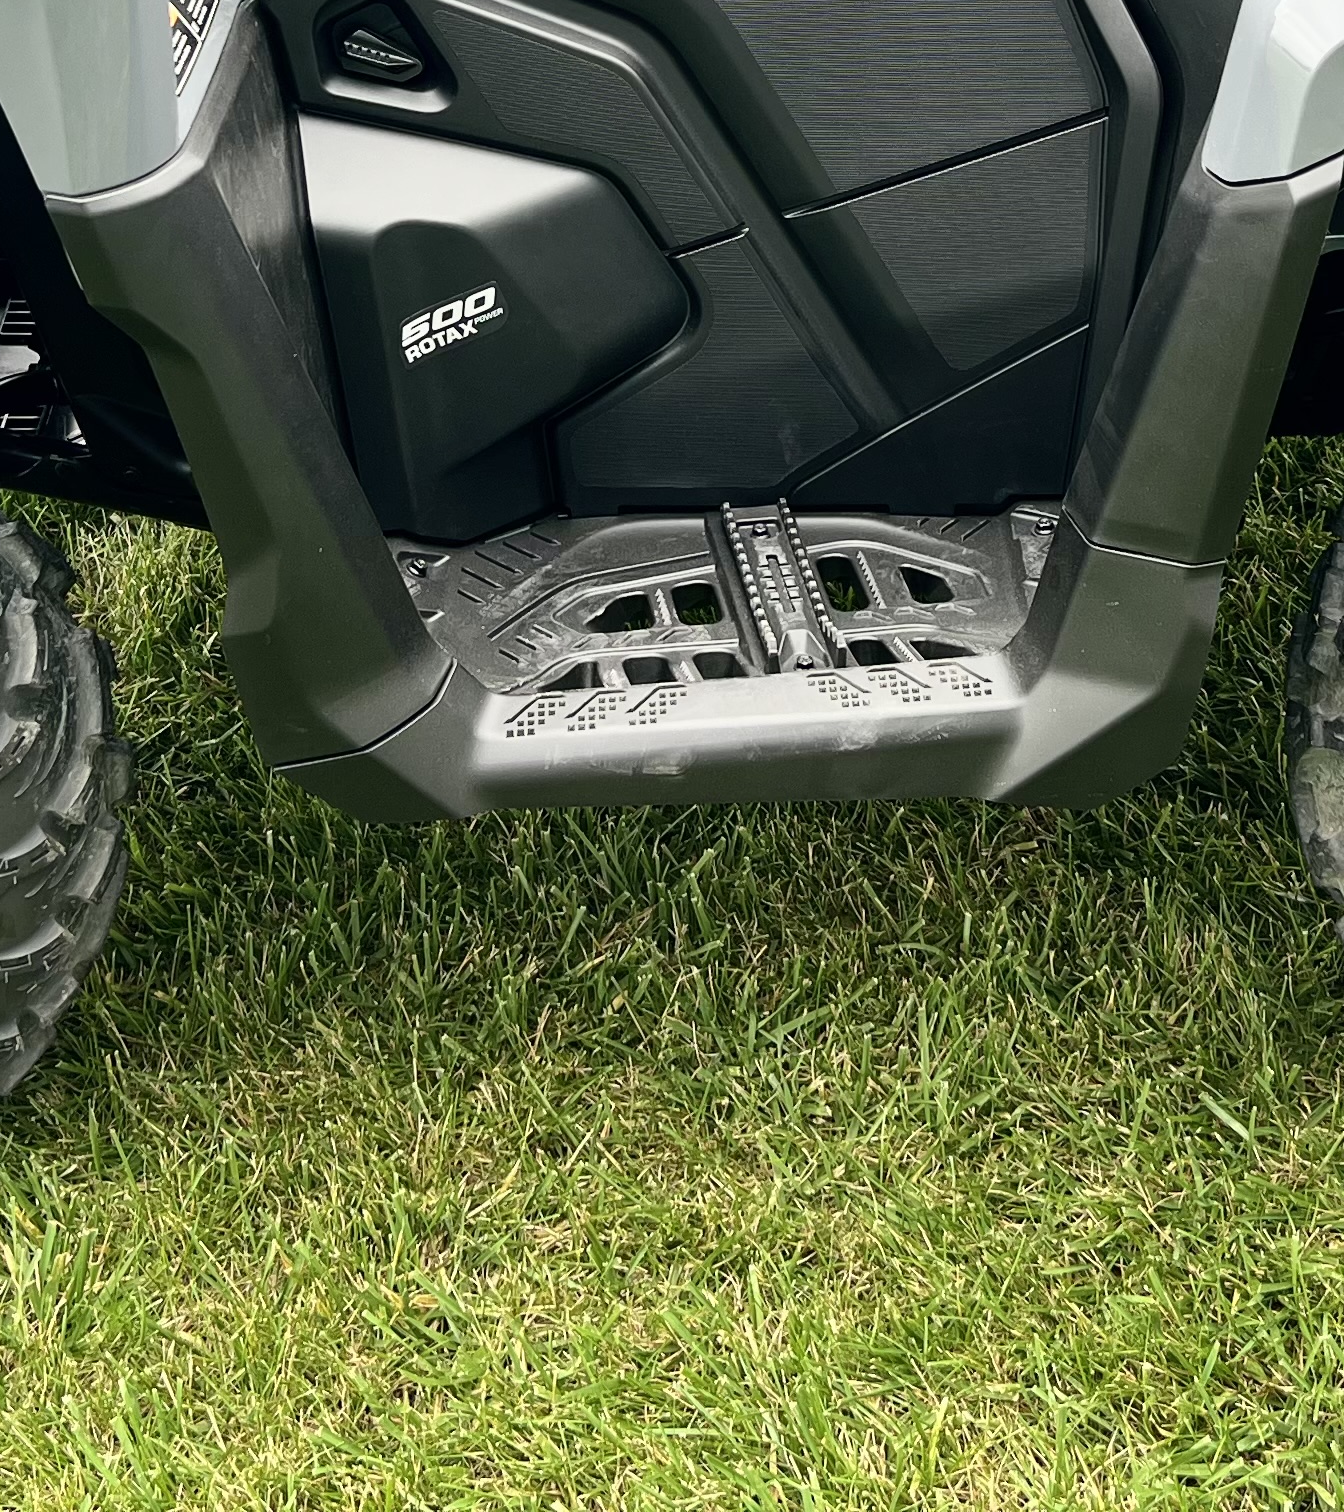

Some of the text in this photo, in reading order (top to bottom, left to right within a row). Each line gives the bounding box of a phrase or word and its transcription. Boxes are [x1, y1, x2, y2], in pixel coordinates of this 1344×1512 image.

[401, 286, 496, 348] 500
[404, 307, 504, 364] ROTAX POWER
